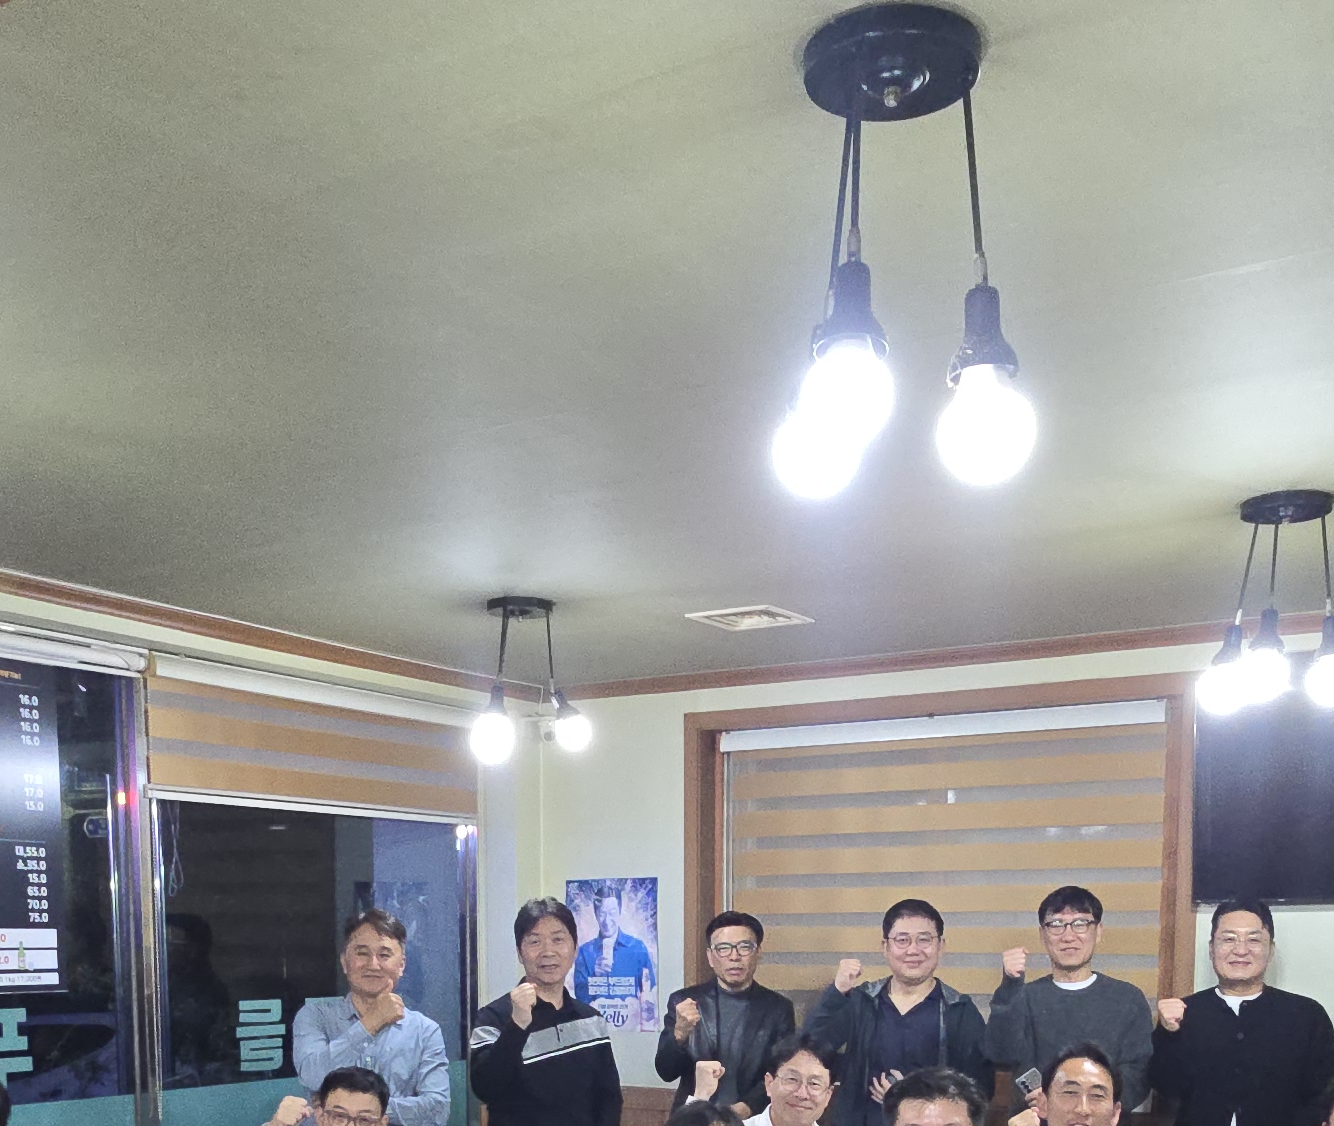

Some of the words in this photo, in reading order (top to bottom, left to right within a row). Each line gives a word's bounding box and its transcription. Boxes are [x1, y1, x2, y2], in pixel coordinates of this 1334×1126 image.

[19, 693, 38, 707] 16.0
[20, 707, 39, 720] 16.0
[20, 721, 40, 733] 16.0
[21, 734, 39, 747] 16.0
[24, 787, 44, 799] 17.0
[25, 800, 44, 812] 15.0
[27, 873, 47, 884] 15.0
[26, 886, 48, 897] 65.0
[27, 899, 49, 910] 70.0
[28, 912, 49, 923] 75.0
